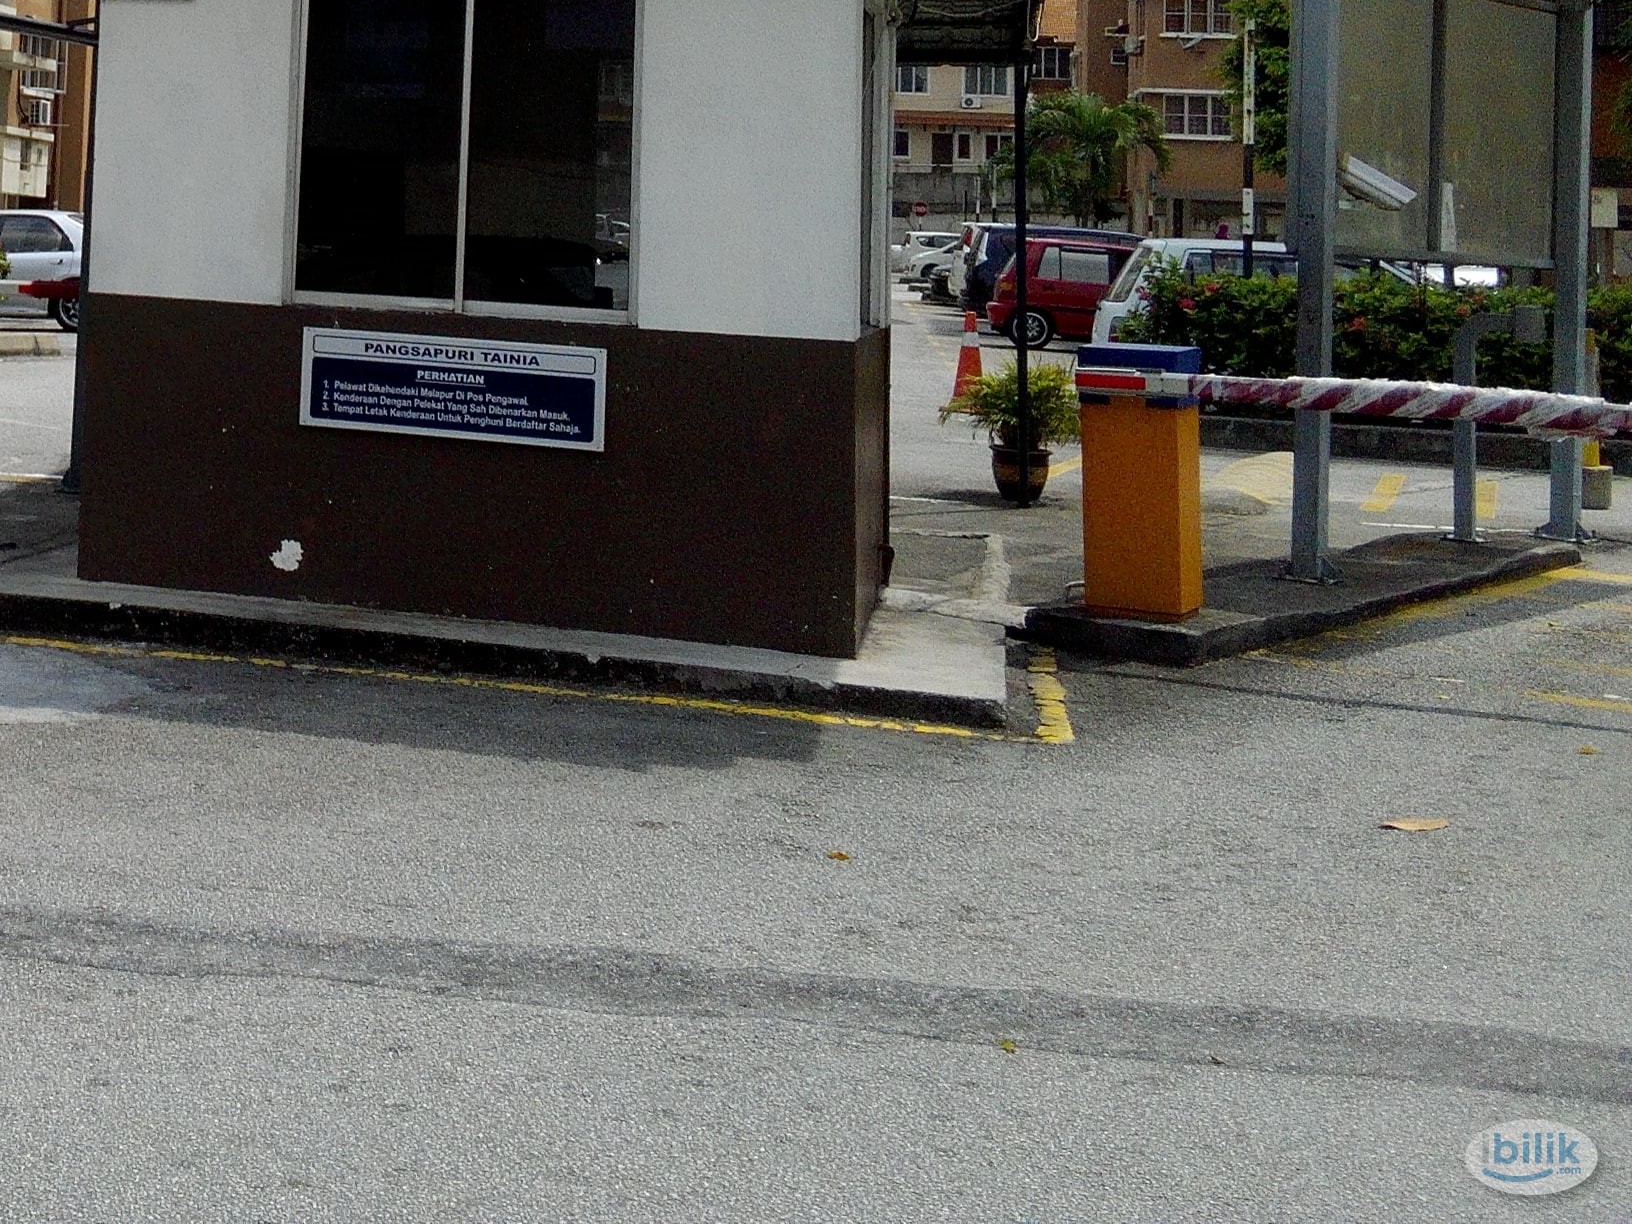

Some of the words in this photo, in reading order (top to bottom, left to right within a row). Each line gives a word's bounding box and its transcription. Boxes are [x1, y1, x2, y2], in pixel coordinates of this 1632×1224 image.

[364, 342, 475, 362] PANGSAPURI
[480, 351, 541, 367] TAINIA
[416, 370, 485, 385] PERHATIAN
[333, 380, 367, 392] Pelawat
[367, 383, 419, 397] Dikehendaki
[421, 387, 455, 400] Melapur
[456, 389, 465, 400] Di
[467, 391, 484, 401] Pos
[322, 391, 330, 400] 2.
[333, 392, 378, 404] Kenderaan
[379, 396, 412, 409] Dengan
[414, 398, 445, 410] Pelekat
[447, 402, 468, 413] Yang
[469, 403, 487, 414] Sah
[488, 405, 538, 418] Dibenarkan
[322, 402, 330, 411] 3.
[333, 402, 363, 415] Tempat
[365, 406, 388, 417] Letak
[389, 408, 436, 421] Kenderaan
[437, 412, 462, 423] Untuk
[464, 414, 504, 427] Penghuni
[505, 418, 548, 431] Berdaftar
